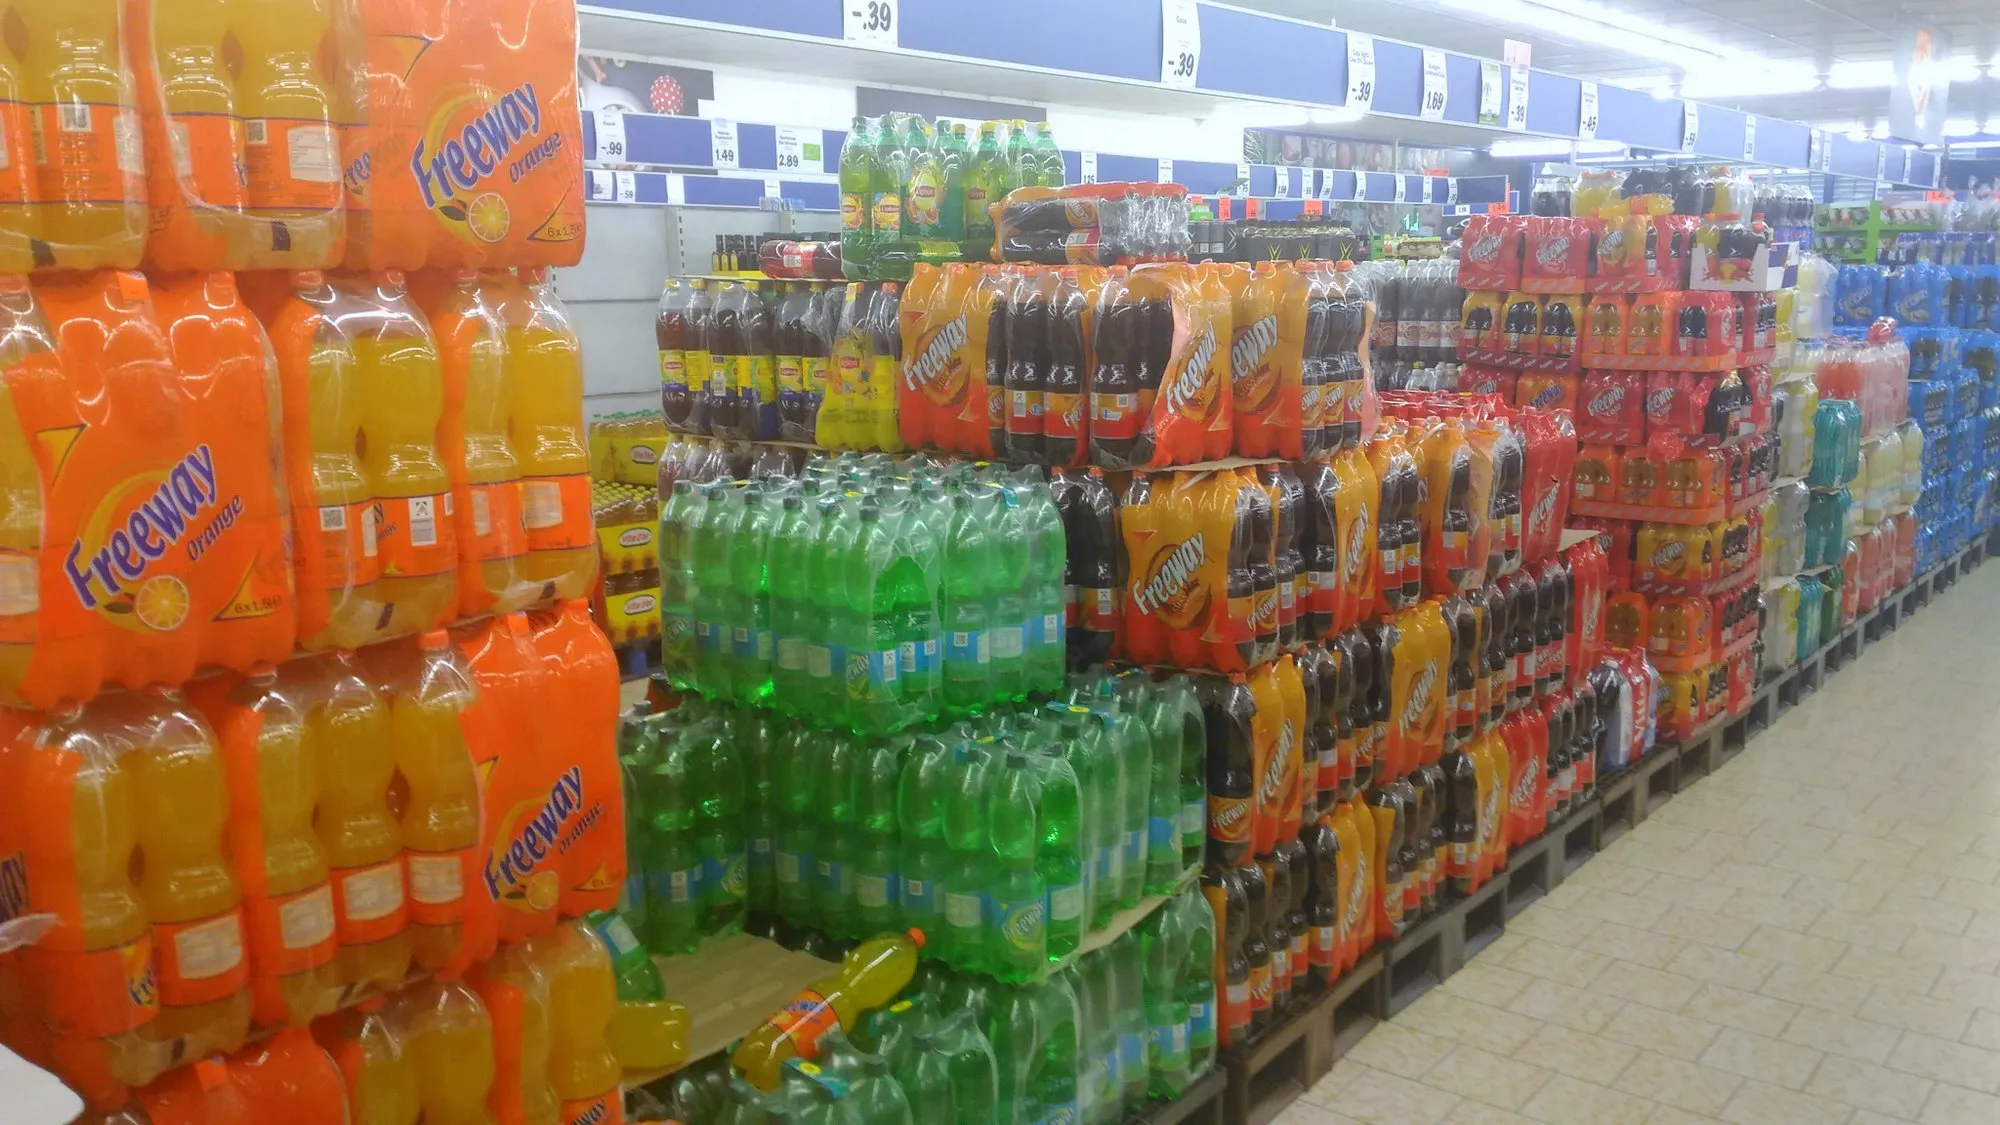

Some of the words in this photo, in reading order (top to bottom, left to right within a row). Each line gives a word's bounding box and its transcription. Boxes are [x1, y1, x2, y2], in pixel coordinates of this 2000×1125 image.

[852, 0, 891, 32] -.39
[1168, 52, 1194, 77] -.39
[1351, 81, 1371, 102] -.39
[1426, 90, 1444, 110] 1.69
[411, 82, 539, 209] Freeway
[509, 131, 562, 184] Orange
[601, 141, 623, 155] -.99
[715, 148, 734, 161] 1.49
[778, 154, 799, 168] 2.89
[902, 312, 968, 392] Freeway
[1166, 319, 1217, 414] Freeway
[1588, 386, 1625, 417] Freeway
[64, 443, 217, 610] Freeway
[186, 494, 244, 561] Orange
[1133, 531, 1205, 616] Freeway
[483, 765, 584, 904] Freeway
